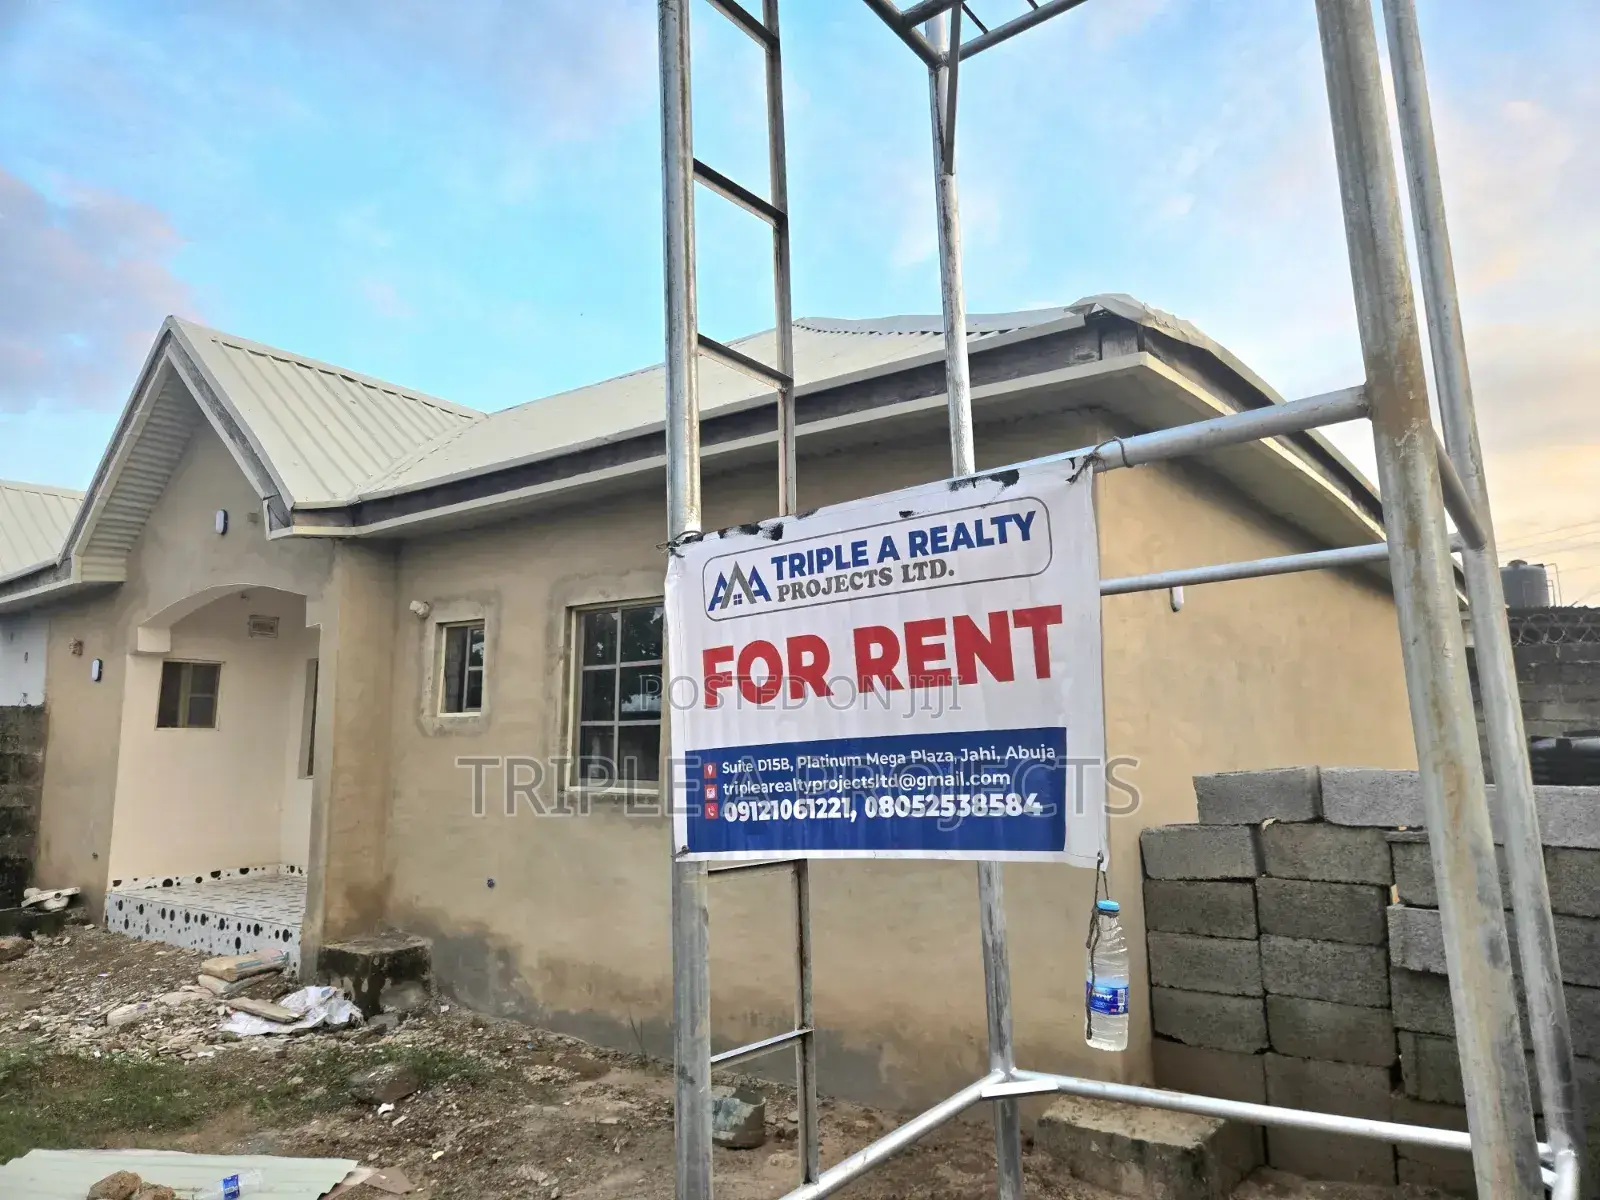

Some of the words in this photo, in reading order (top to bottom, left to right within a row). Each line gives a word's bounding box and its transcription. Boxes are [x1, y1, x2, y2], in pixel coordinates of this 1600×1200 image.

[771, 540, 869, 580] TRIPLE
[876, 535, 901, 563] A
[908, 511, 1037, 558] REALTY
[776, 567, 894, 603] PROJECTS
[901, 558, 955, 583] LTD.
[702, 633, 835, 709] FOR
[853, 604, 1063, 694] RENT
[722, 760, 754, 774] Suite
[758, 758, 794, 772] D15B,
[797, 754, 862, 769] Platinum
[866, 752, 906, 768] Mega
[911, 749, 957, 764] Plaza,
[960, 745, 1001, 763] Jahi,
[1005, 744, 1056, 762] Abuja
[722, 771, 1011, 798] triplearealtyprojectsltd@gmail.com
[723, 797, 857, 823] 09121061221,
[864, 793, 1044, 819] 08052538584
